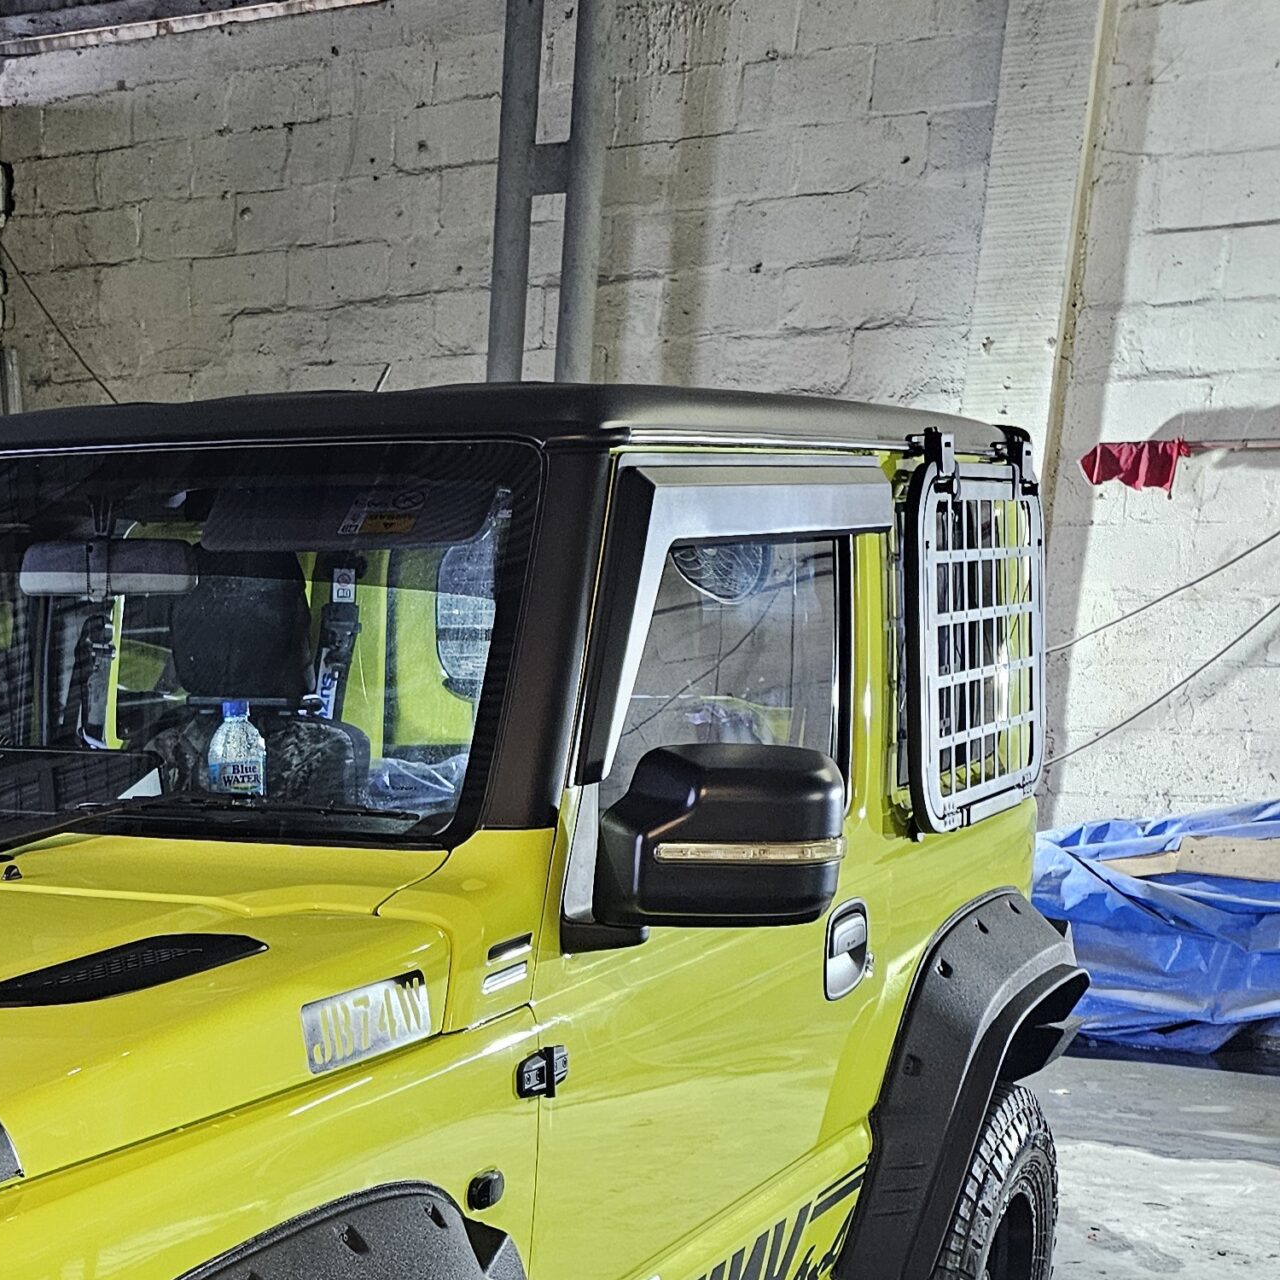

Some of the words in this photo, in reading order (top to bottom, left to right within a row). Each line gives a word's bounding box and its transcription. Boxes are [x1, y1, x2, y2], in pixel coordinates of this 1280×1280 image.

[232, 764, 257, 774] Blue
[223, 773, 261, 786] WATER
[313, 977, 422, 1065] JB74W
